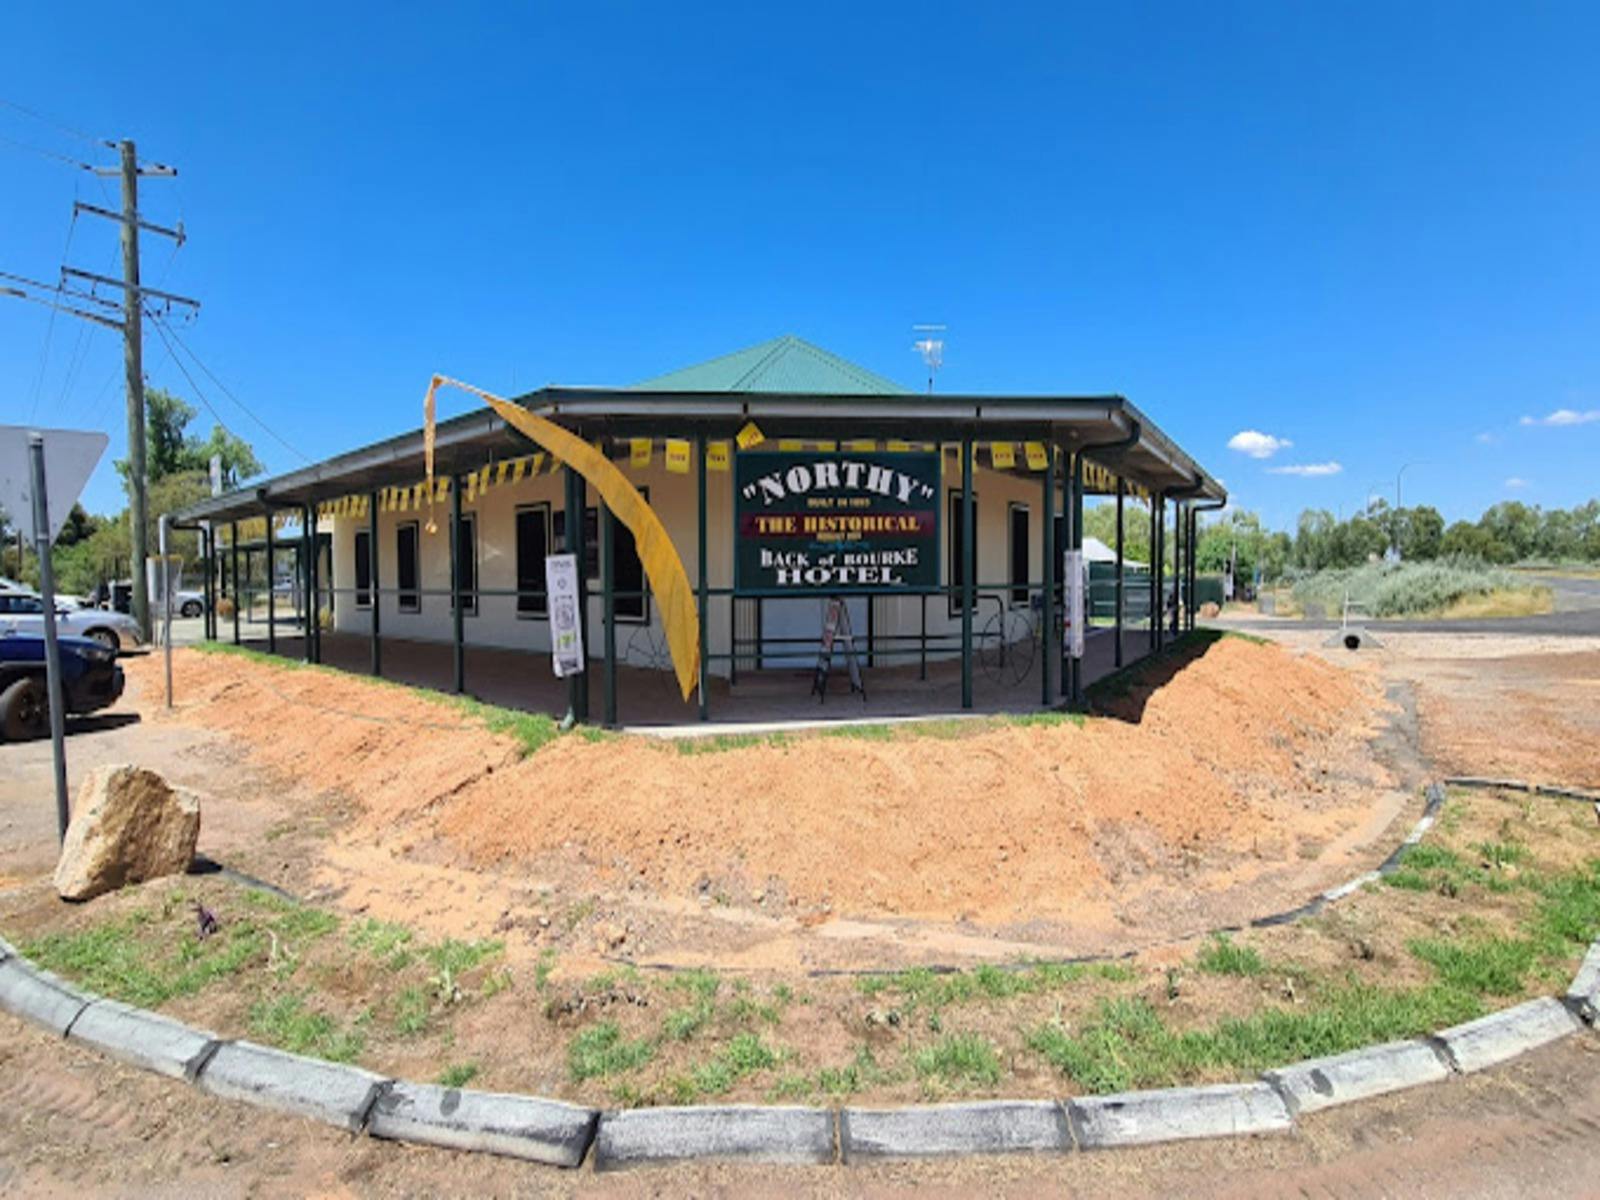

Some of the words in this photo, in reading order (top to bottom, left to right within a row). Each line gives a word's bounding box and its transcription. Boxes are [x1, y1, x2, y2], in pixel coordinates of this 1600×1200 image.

[742, 461, 934, 505] "NORTHY"
[756, 516, 796, 534] THE
[804, 515, 920, 533] HISTORICAL
[760, 548, 809, 568] BACK
[818, 553, 836, 566] of
[844, 548, 918, 566] BOURKE
[776, 567, 902, 585] HOTEL
